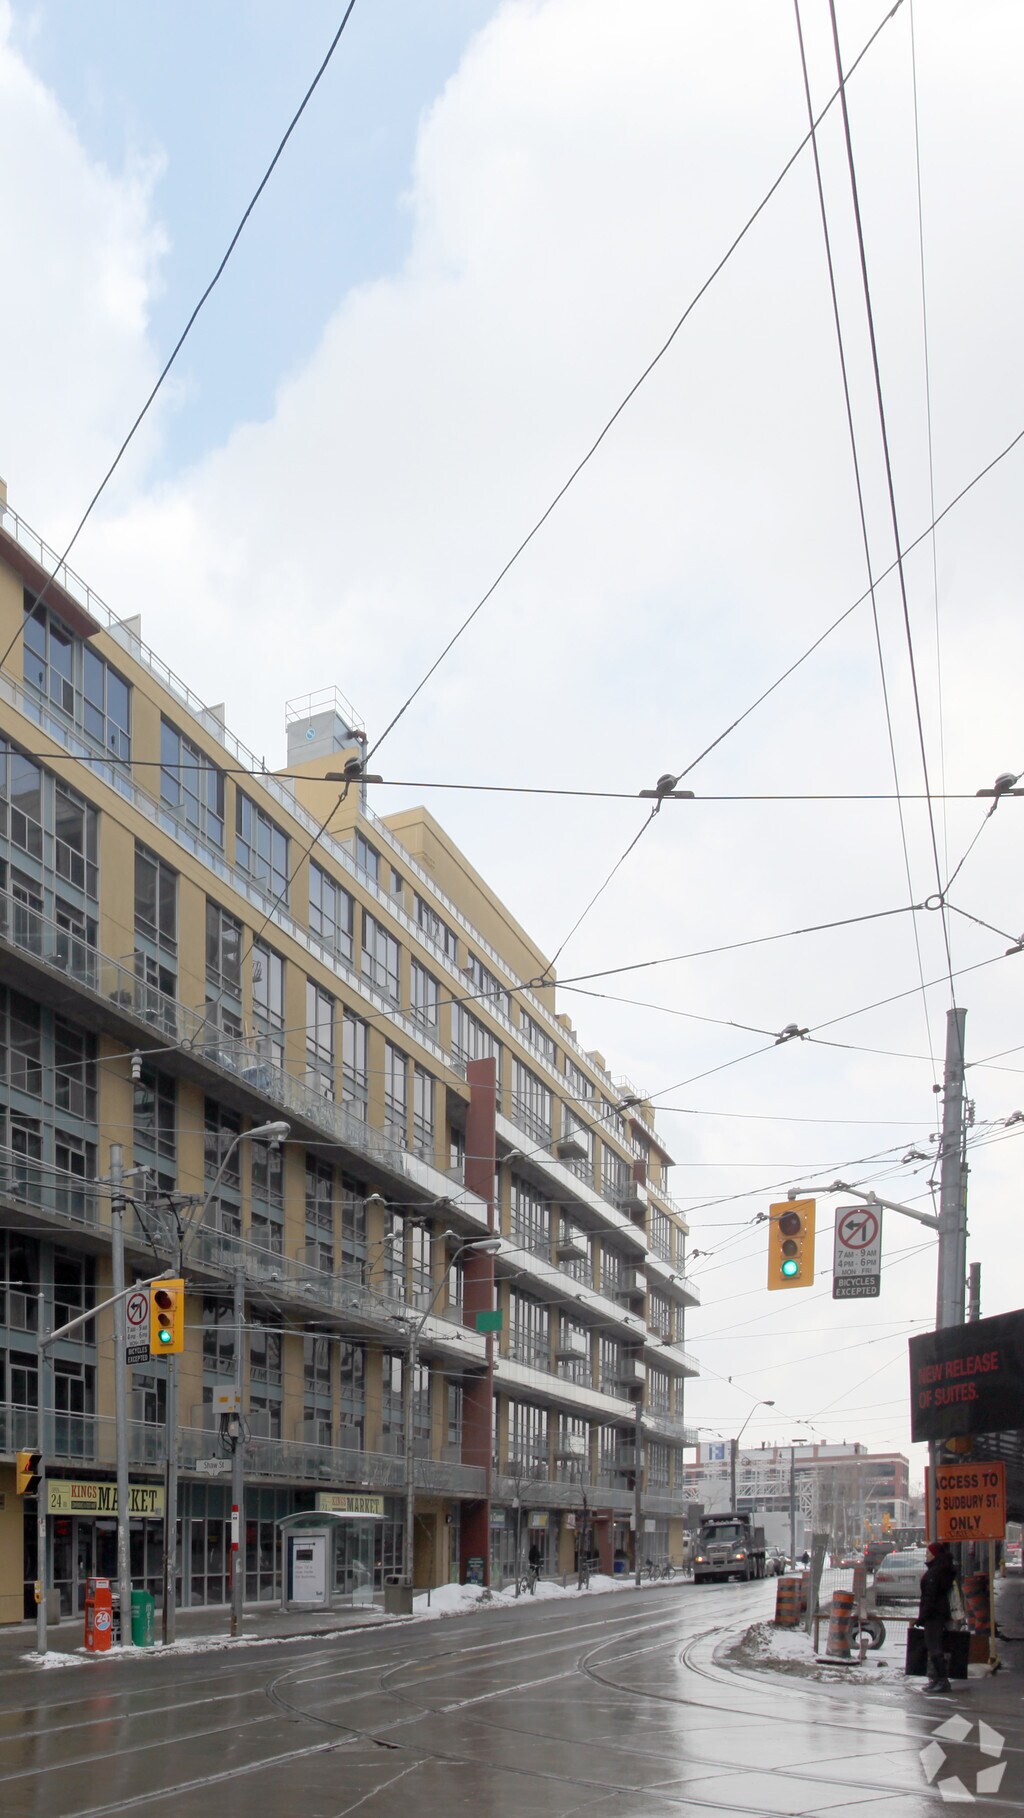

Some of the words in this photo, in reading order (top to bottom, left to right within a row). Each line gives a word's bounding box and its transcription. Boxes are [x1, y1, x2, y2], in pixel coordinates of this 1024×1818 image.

[838, 1277, 875, 1287] BICYCLES
[836, 1286, 877, 1297] EXCEPTED
[128, 1347, 147, 1355] BICYCLES
[127, 1355, 148, 1363] EXCEPTED
[918, 1363, 943, 1386] NEW
[945, 1351, 999, 1379] RELEASE
[918, 1390, 933, 1409] OF
[934, 1382, 980, 1407] SUITES.
[203, 1461, 218, 1469] Shaw
[219, 1460, 225, 1469] St
[982, 1472, 999, 1487] TO
[51, 1494, 62, 1508] 24
[71, 1484, 97, 1498] KINGS
[97, 1486, 157, 1512] MAKET
[332, 1495, 347, 1506] KINGS
[347, 1497, 379, 1514] MARKET
[943, 1494, 984, 1510] SUDBURY
[986, 1493, 1000, 1508] ST.
[949, 1515, 982, 1531] ONLY
[96, 1612, 108, 1623] 24
